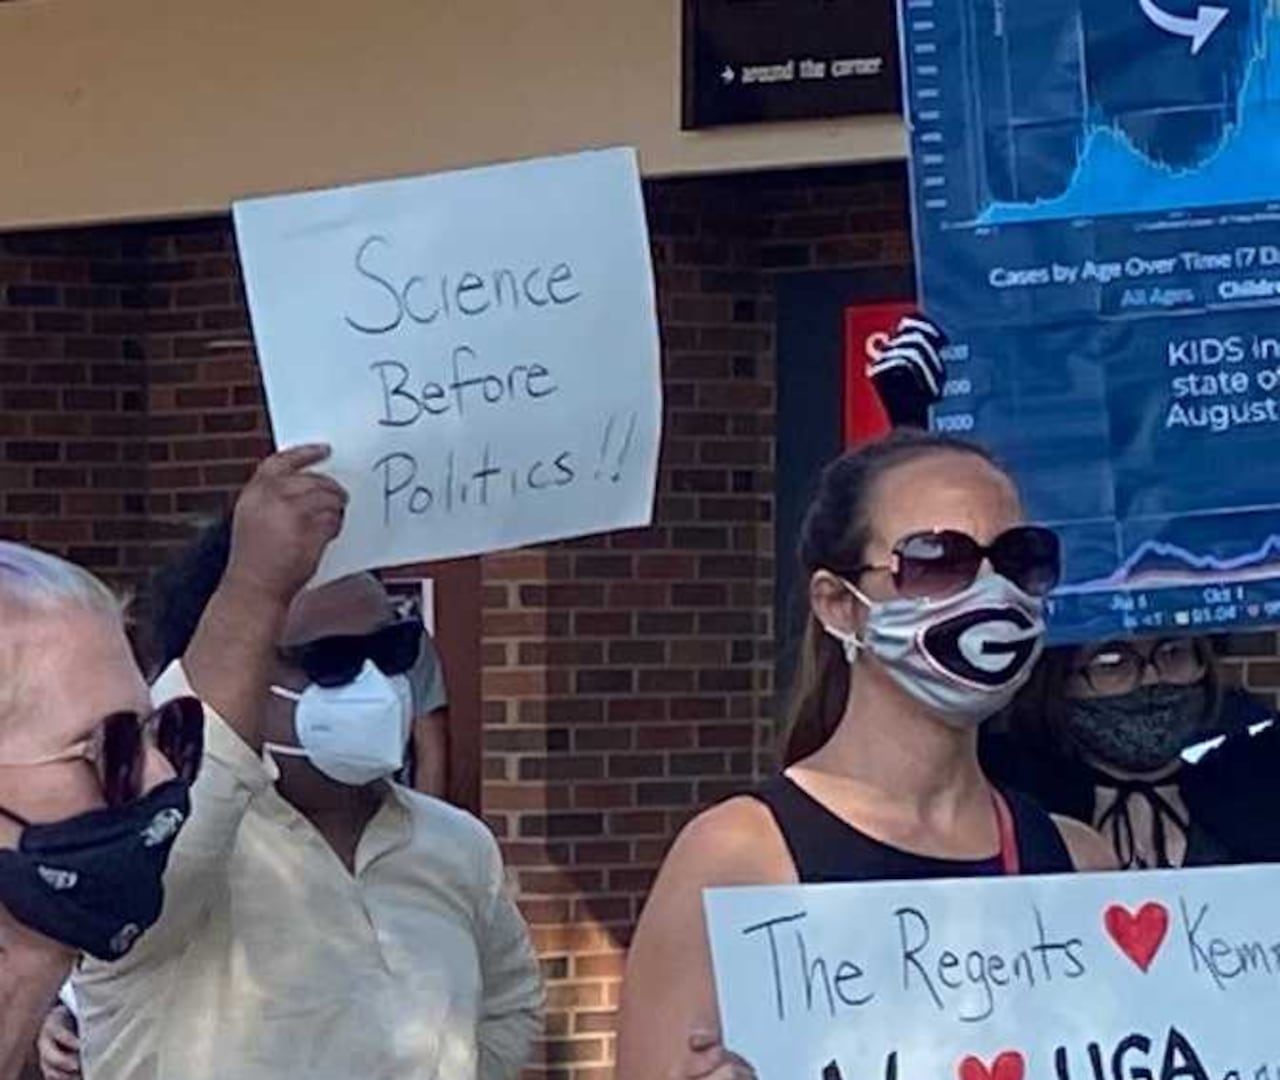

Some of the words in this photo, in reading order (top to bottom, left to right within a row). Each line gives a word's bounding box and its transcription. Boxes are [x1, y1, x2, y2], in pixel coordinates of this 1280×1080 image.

[343, 235, 580, 334] Science
[989, 265, 1050, 288] Cases
[1053, 259, 1079, 284] by
[1081, 258, 1122, 284] Age
[1124, 257, 1177, 277] Over
[1179, 252, 1233, 272] Time
[1167, 336, 1246, 367] KIDS
[369, 346, 559, 428] Before
[1171, 370, 1249, 398] state
[1165, 397, 1278, 432] August
[742, 912, 873, 1021] The
[895, 904, 1086, 1022] Regents
